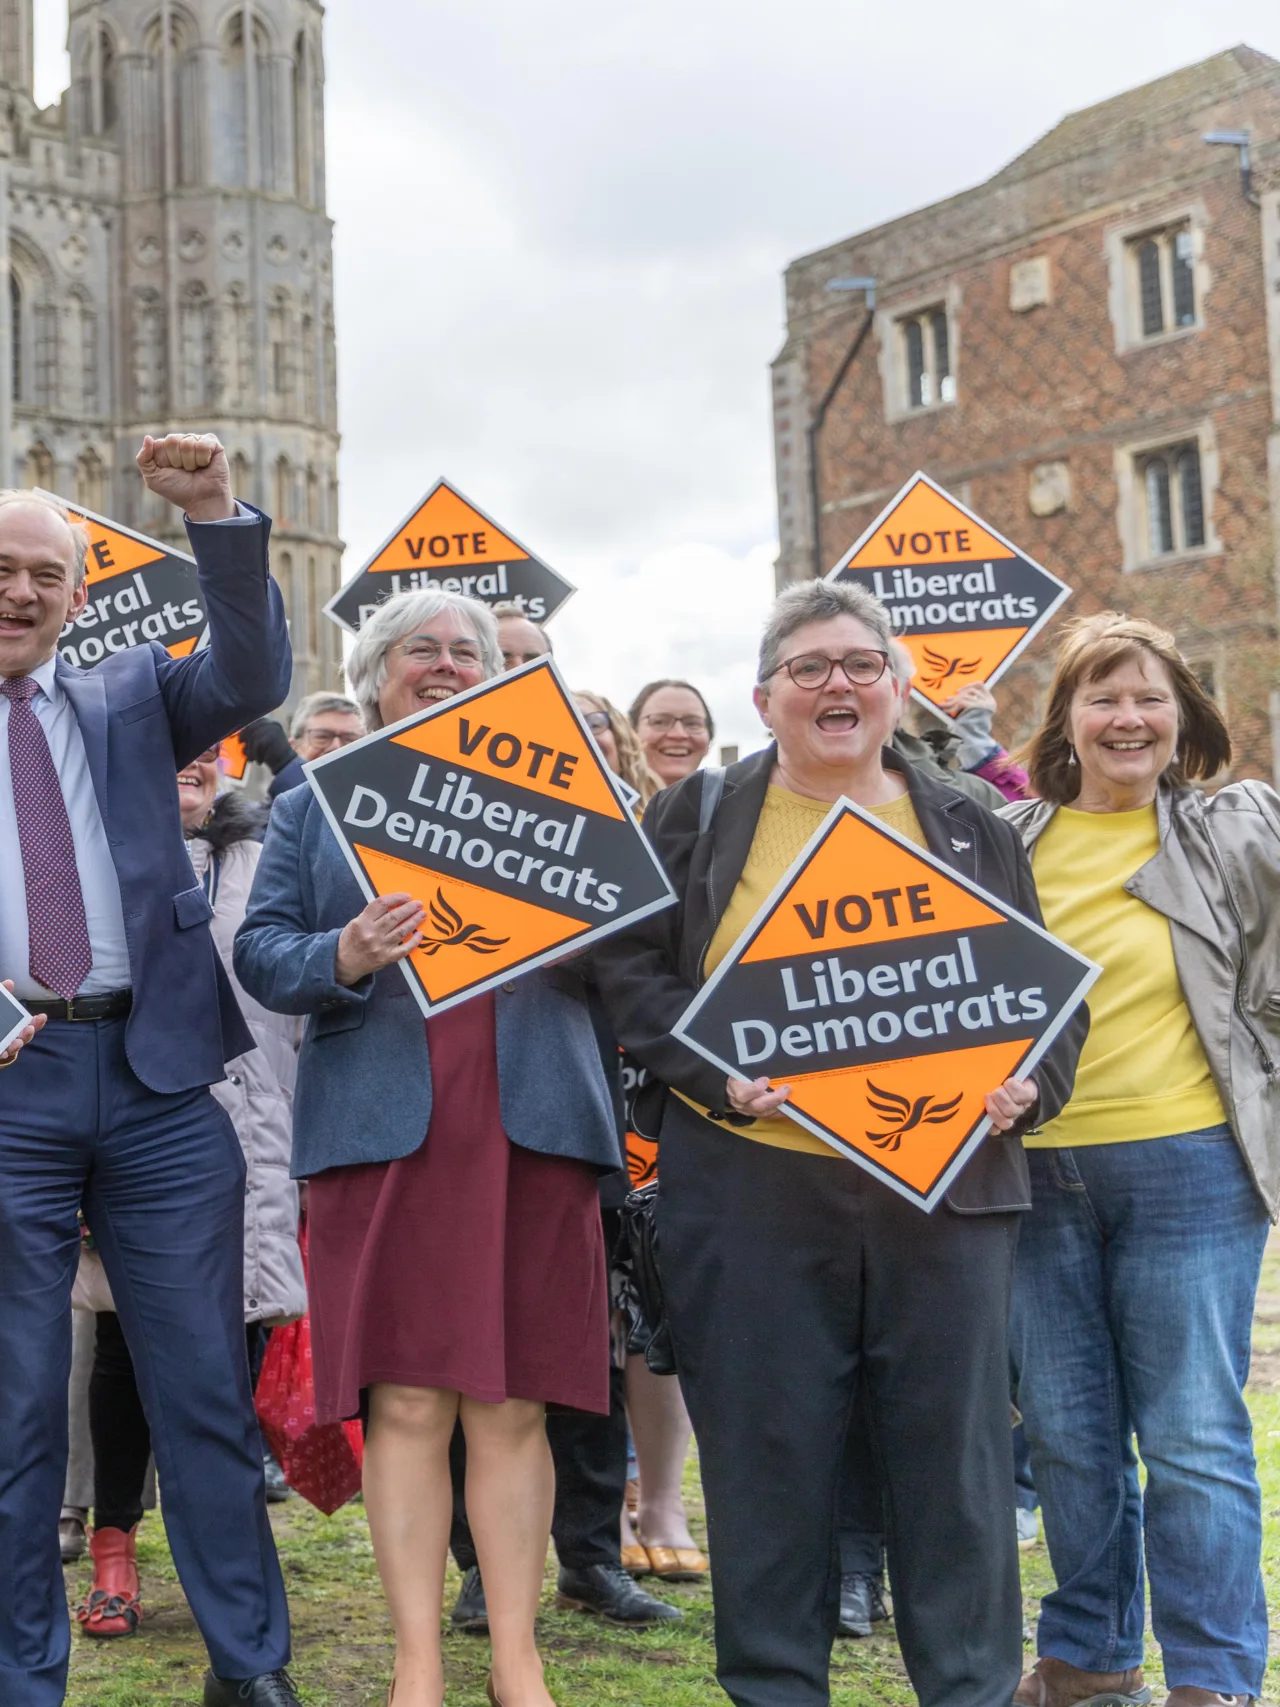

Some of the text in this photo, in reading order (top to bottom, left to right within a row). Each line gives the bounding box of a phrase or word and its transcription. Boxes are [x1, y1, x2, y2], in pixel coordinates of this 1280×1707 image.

[405, 532, 487, 559] VOTE
[885, 529, 972, 556] VOTE
[59, 572, 152, 638] eral
[873, 563, 996, 600] Liberal
[889, 593, 1038, 627] mocrats
[59, 598, 204, 667] ocrats
[458, 717, 579, 790] VOTE
[407, 763, 586, 856] Liberal
[343, 784, 622, 913] Democrats
[793, 883, 935, 940] VOTE
[780, 936, 978, 1011] Liberal
[731, 983, 1048, 1065] Democrats
